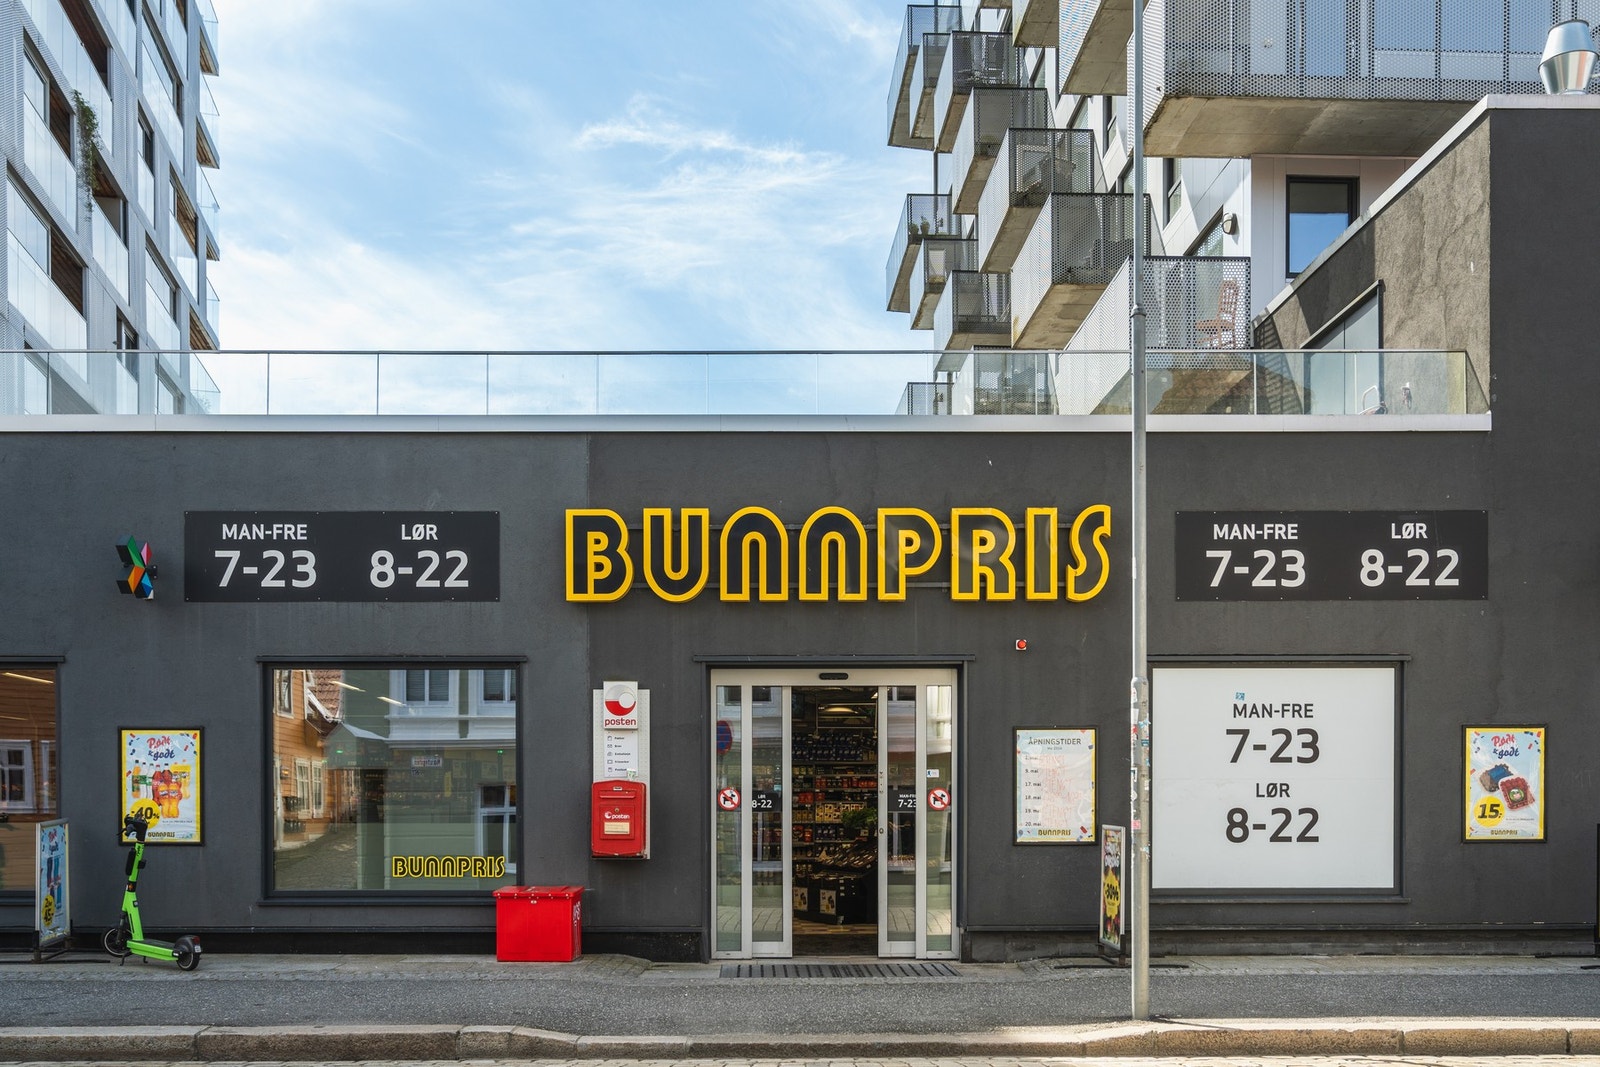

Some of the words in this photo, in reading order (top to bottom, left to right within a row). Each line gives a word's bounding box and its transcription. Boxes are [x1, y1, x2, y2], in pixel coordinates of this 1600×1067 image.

[222, 523, 308, 541] MAN-FRE
[401, 523, 438, 541] LØR
[1213, 523, 1299, 541] MAN-FRE
[1391, 522, 1428, 540] LØR
[566, 503, 1112, 603] BUNNPRIS
[214, 549, 317, 588] 7-23
[369, 549, 469, 589] 8-22
[1205, 549, 1306, 588] 7-23
[1359, 548, 1460, 587] 8-22
[1233, 703, 1314, 719] MAN-FRE
[604, 717, 637, 727] posten
[1028, 736, 1082, 745] ÅPNINGSTIDER
[1225, 728, 1320, 764] 7-23
[153, 748, 176, 762] godt
[1498, 746, 1520, 760] godt
[1256, 782, 1291, 798] LØR
[751, 799, 772, 808] 8-22
[1225, 807, 1320, 844] 8-22
[391, 854, 506, 879] BUNNPRIS
